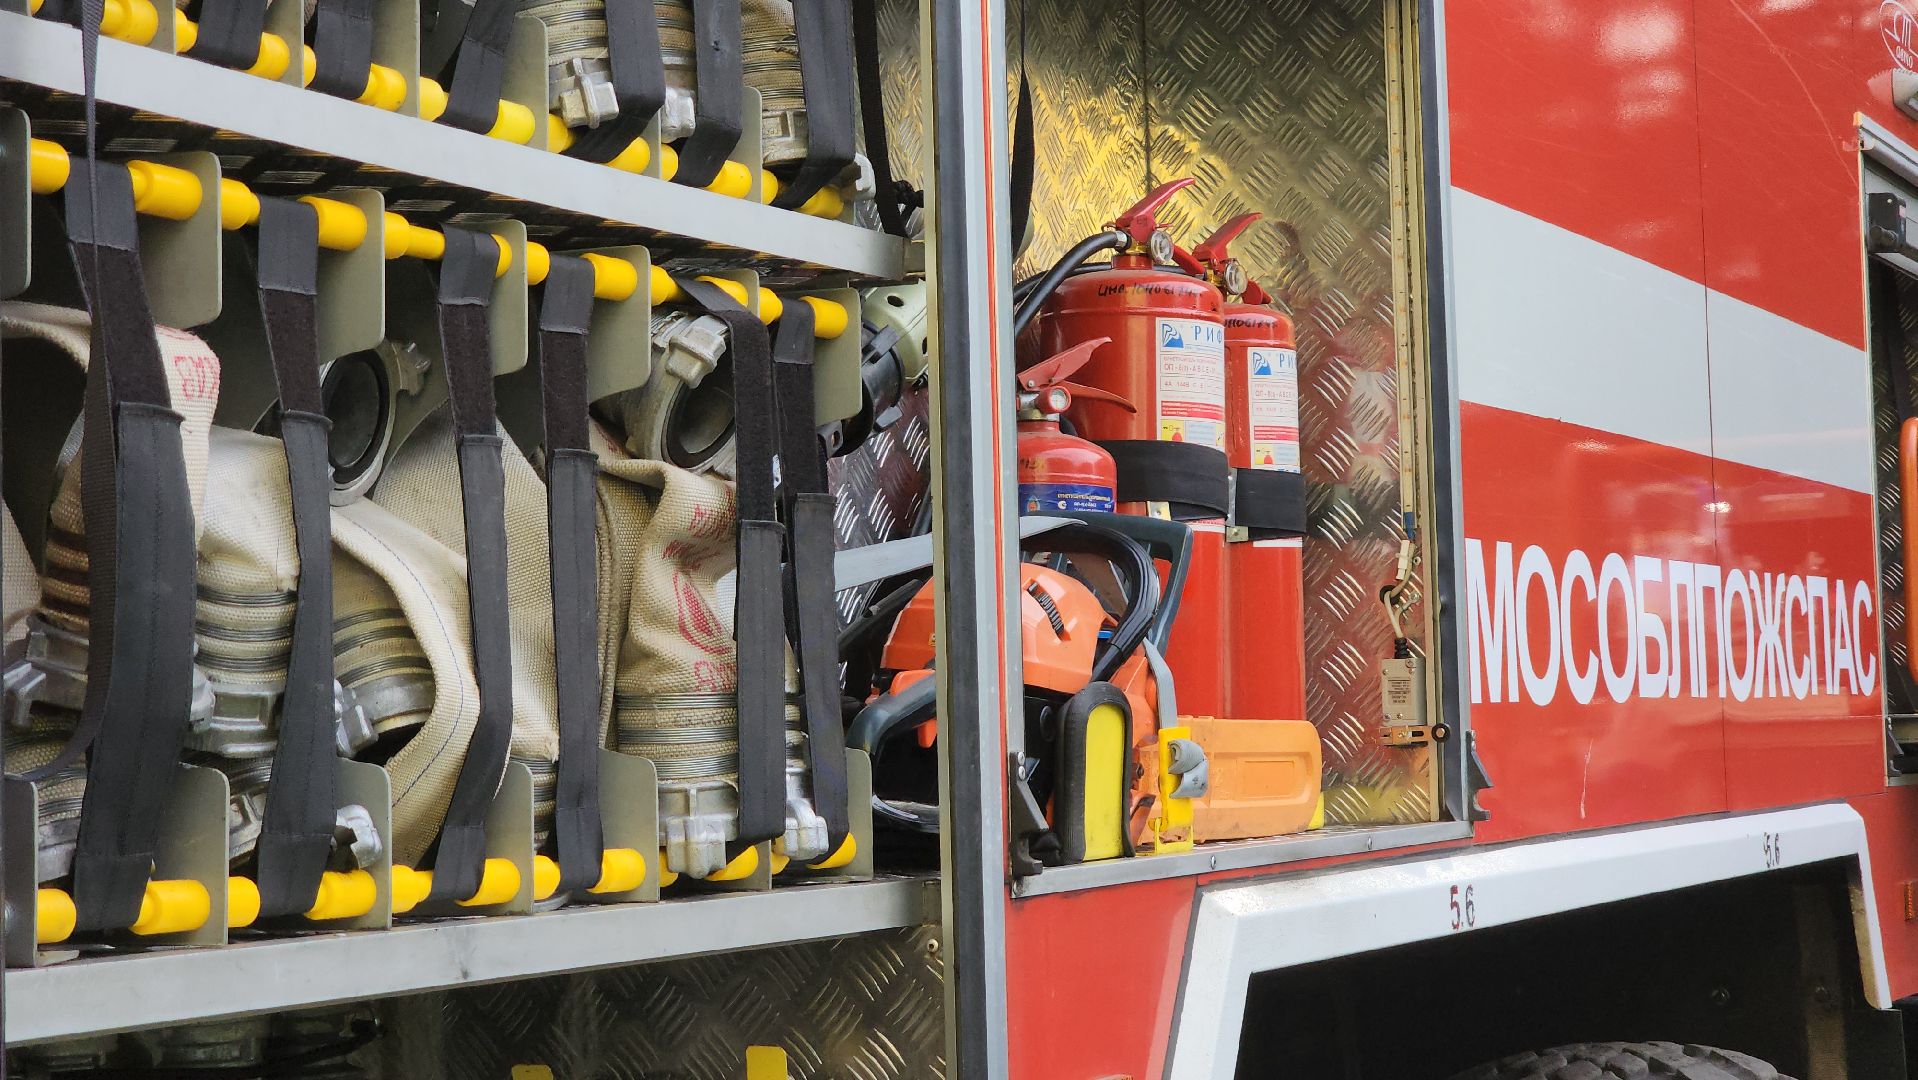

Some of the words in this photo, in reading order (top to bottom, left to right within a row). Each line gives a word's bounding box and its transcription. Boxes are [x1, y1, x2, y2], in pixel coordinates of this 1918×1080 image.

[1279, 352, 1297, 369] РИ
[1465, 538, 1876, 706] МОСОБЛПОЖСПАС
[1450, 884, 1475, 931] 5.6
